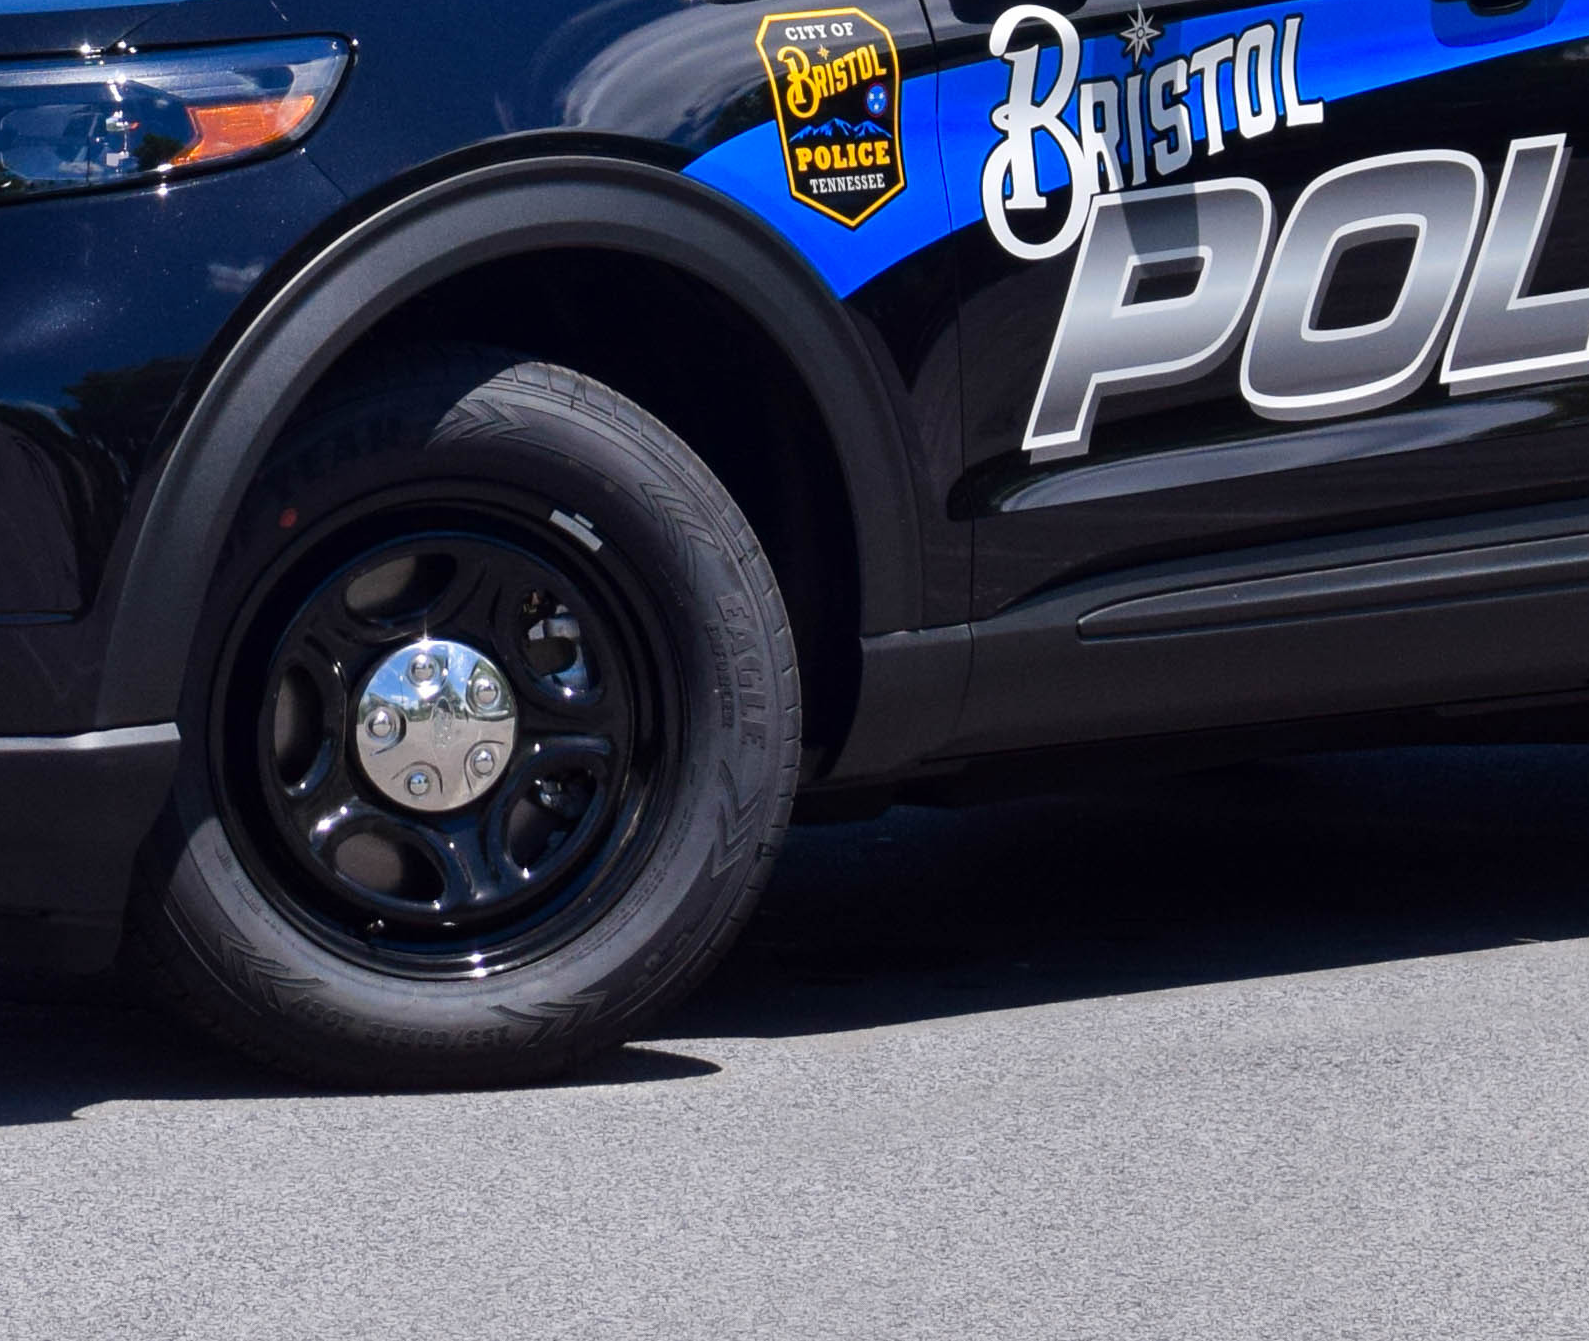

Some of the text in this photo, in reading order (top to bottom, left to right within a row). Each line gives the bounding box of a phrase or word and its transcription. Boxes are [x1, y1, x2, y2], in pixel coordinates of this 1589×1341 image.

[785, 22, 854, 42] CITY OF
[777, 44, 887, 119] BRISTOL
[795, 140, 891, 172] POLICE
[982, 4, 1324, 260] BRISTOL
[809, 173, 886, 194] TENNESSEE
[716, 593, 767, 750] EAGLE
